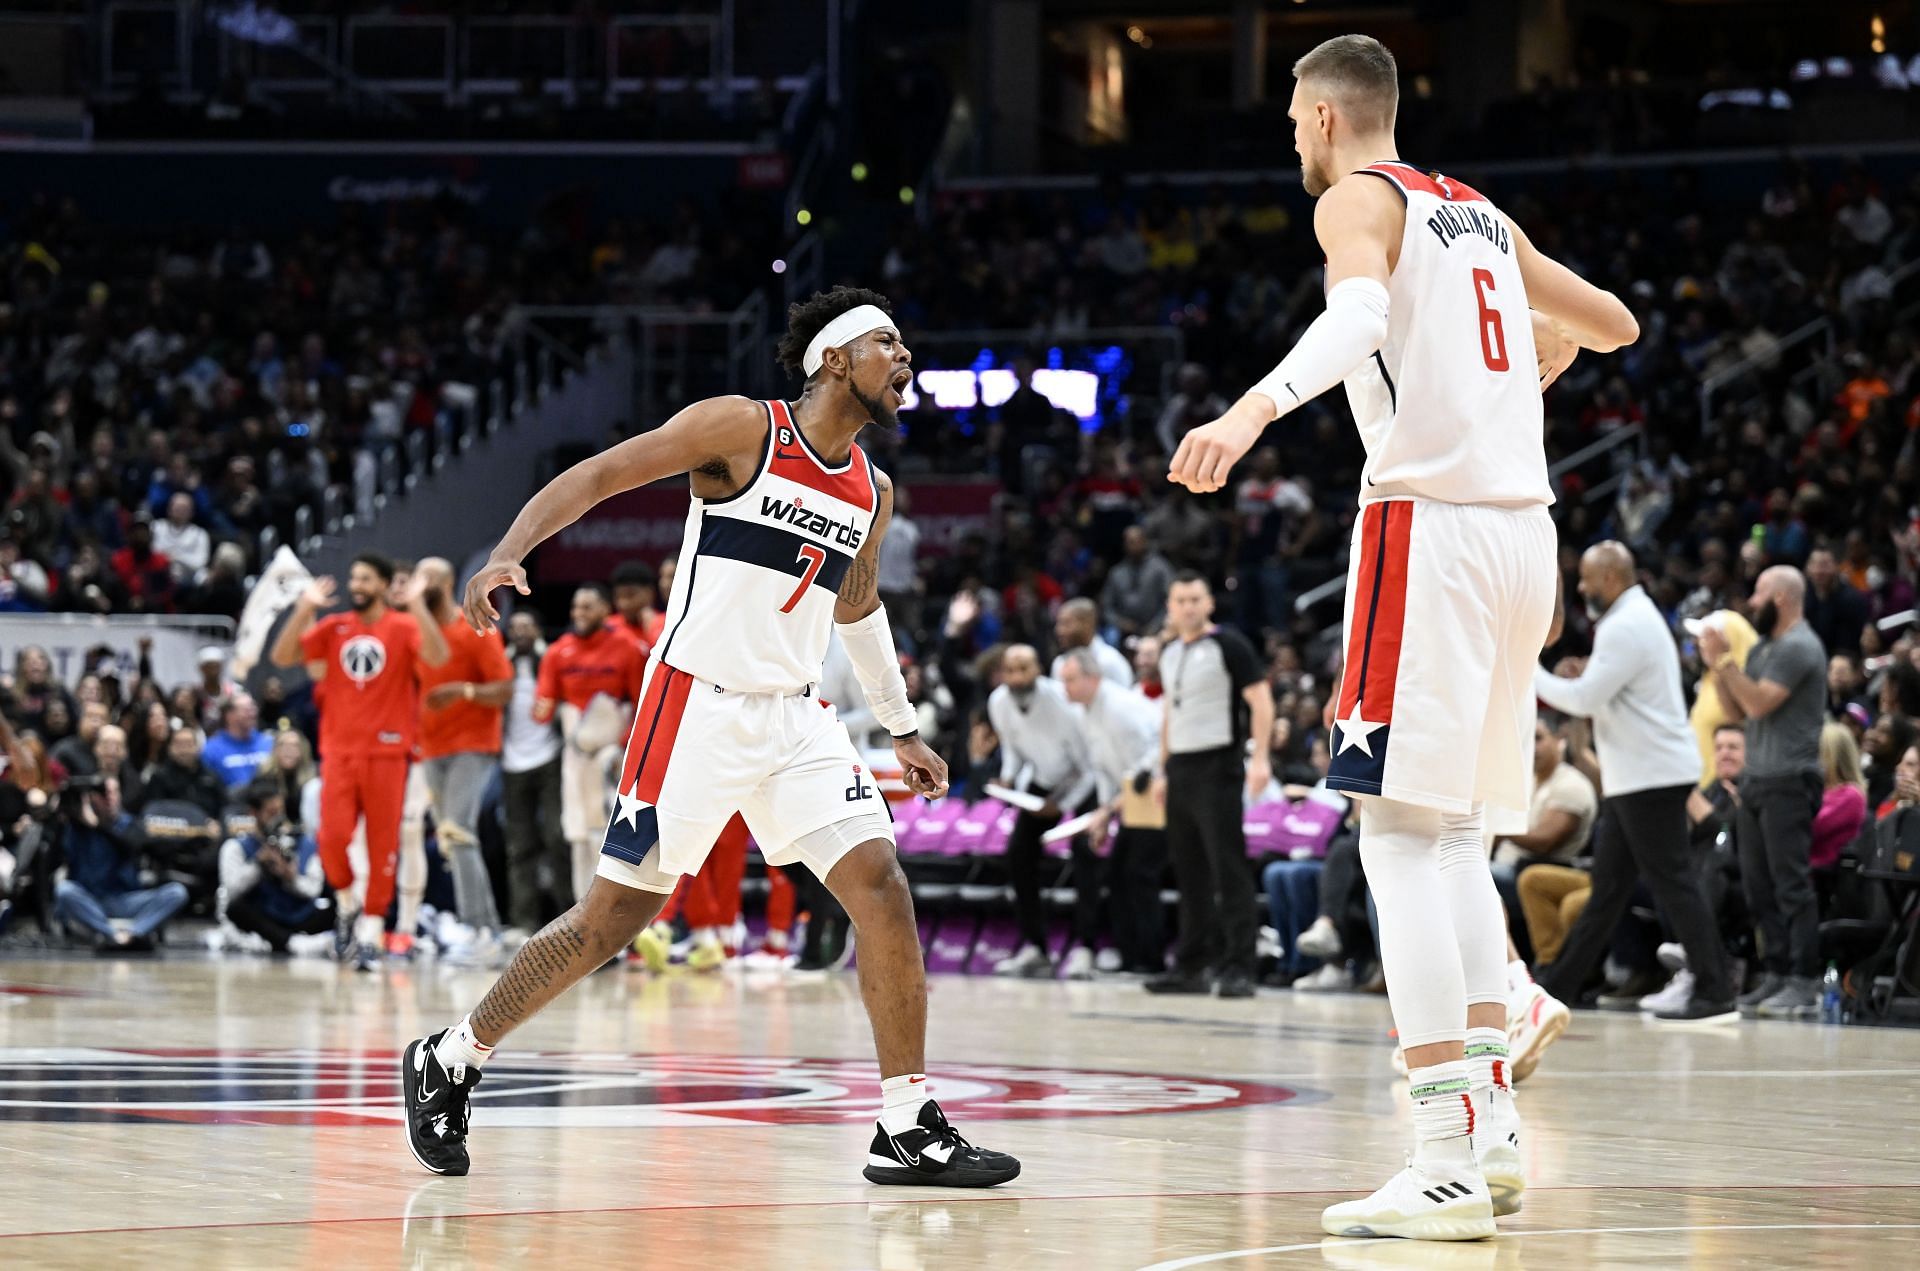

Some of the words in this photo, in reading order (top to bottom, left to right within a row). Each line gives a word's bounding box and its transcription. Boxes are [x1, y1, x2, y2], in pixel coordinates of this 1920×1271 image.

[1427, 204, 1509, 255] PORZINGIS
[1472, 267, 1510, 372] 6
[779, 428, 791, 445] 6
[760, 496, 863, 549] wizards
[779, 542, 827, 614] 7
[845, 772, 873, 802] dc
